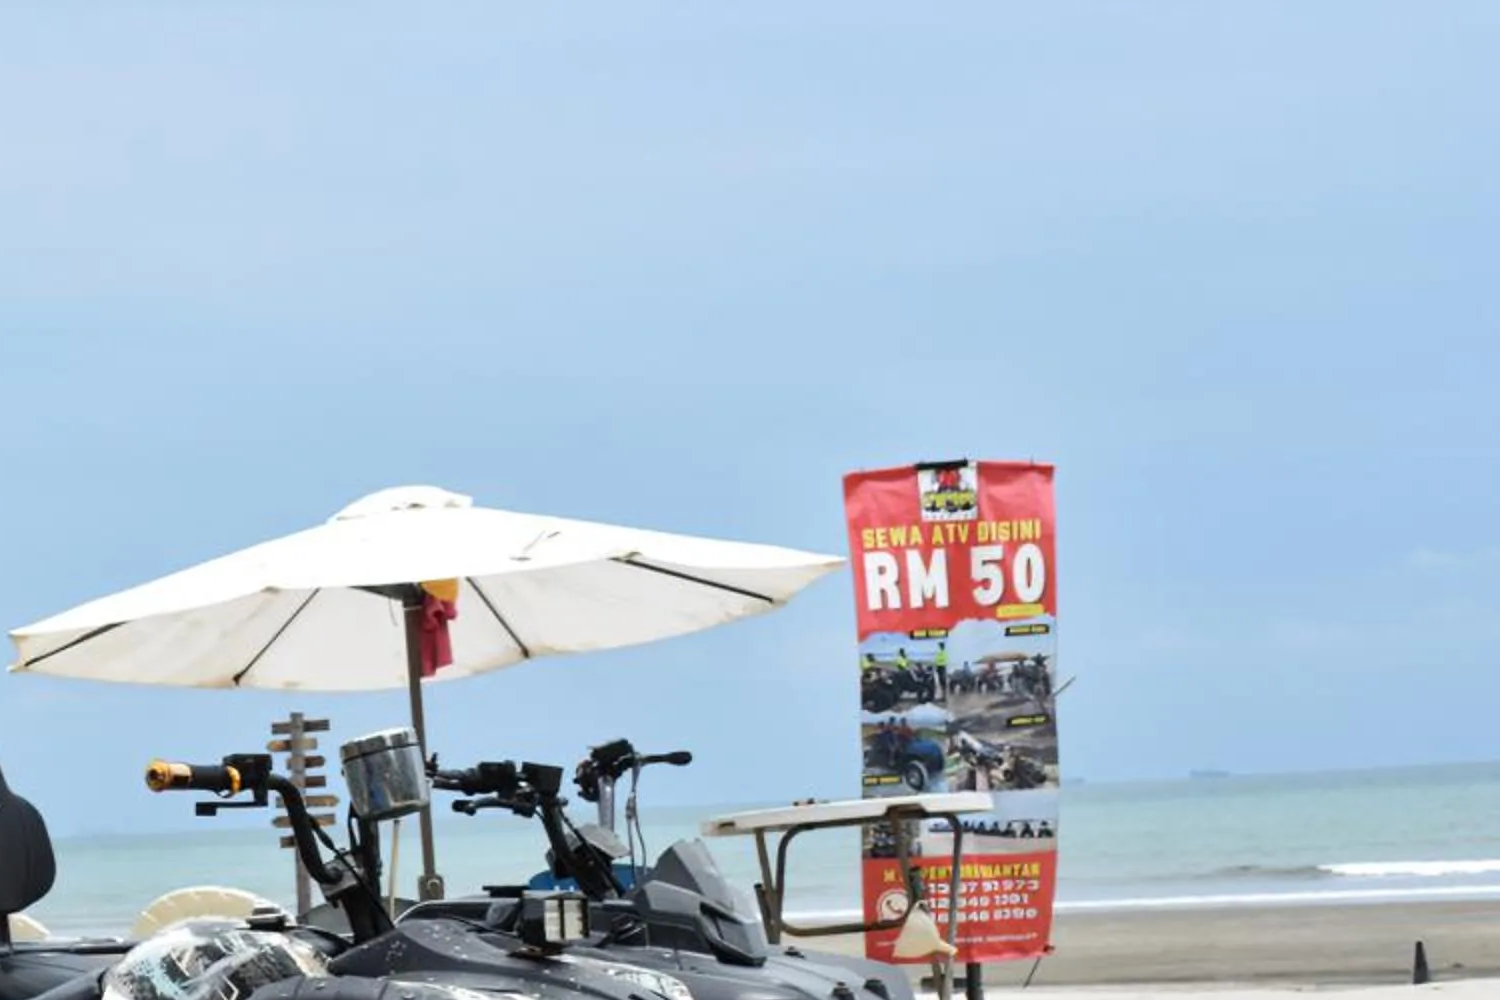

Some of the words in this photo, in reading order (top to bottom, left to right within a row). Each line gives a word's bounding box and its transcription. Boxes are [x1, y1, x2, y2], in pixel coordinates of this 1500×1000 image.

[861, 525, 923, 549] SEWA
[932, 522, 969, 545] ATV
[977, 518, 1042, 543] DISINI
[863, 548, 950, 611] RM
[970, 543, 1045, 606] 50
